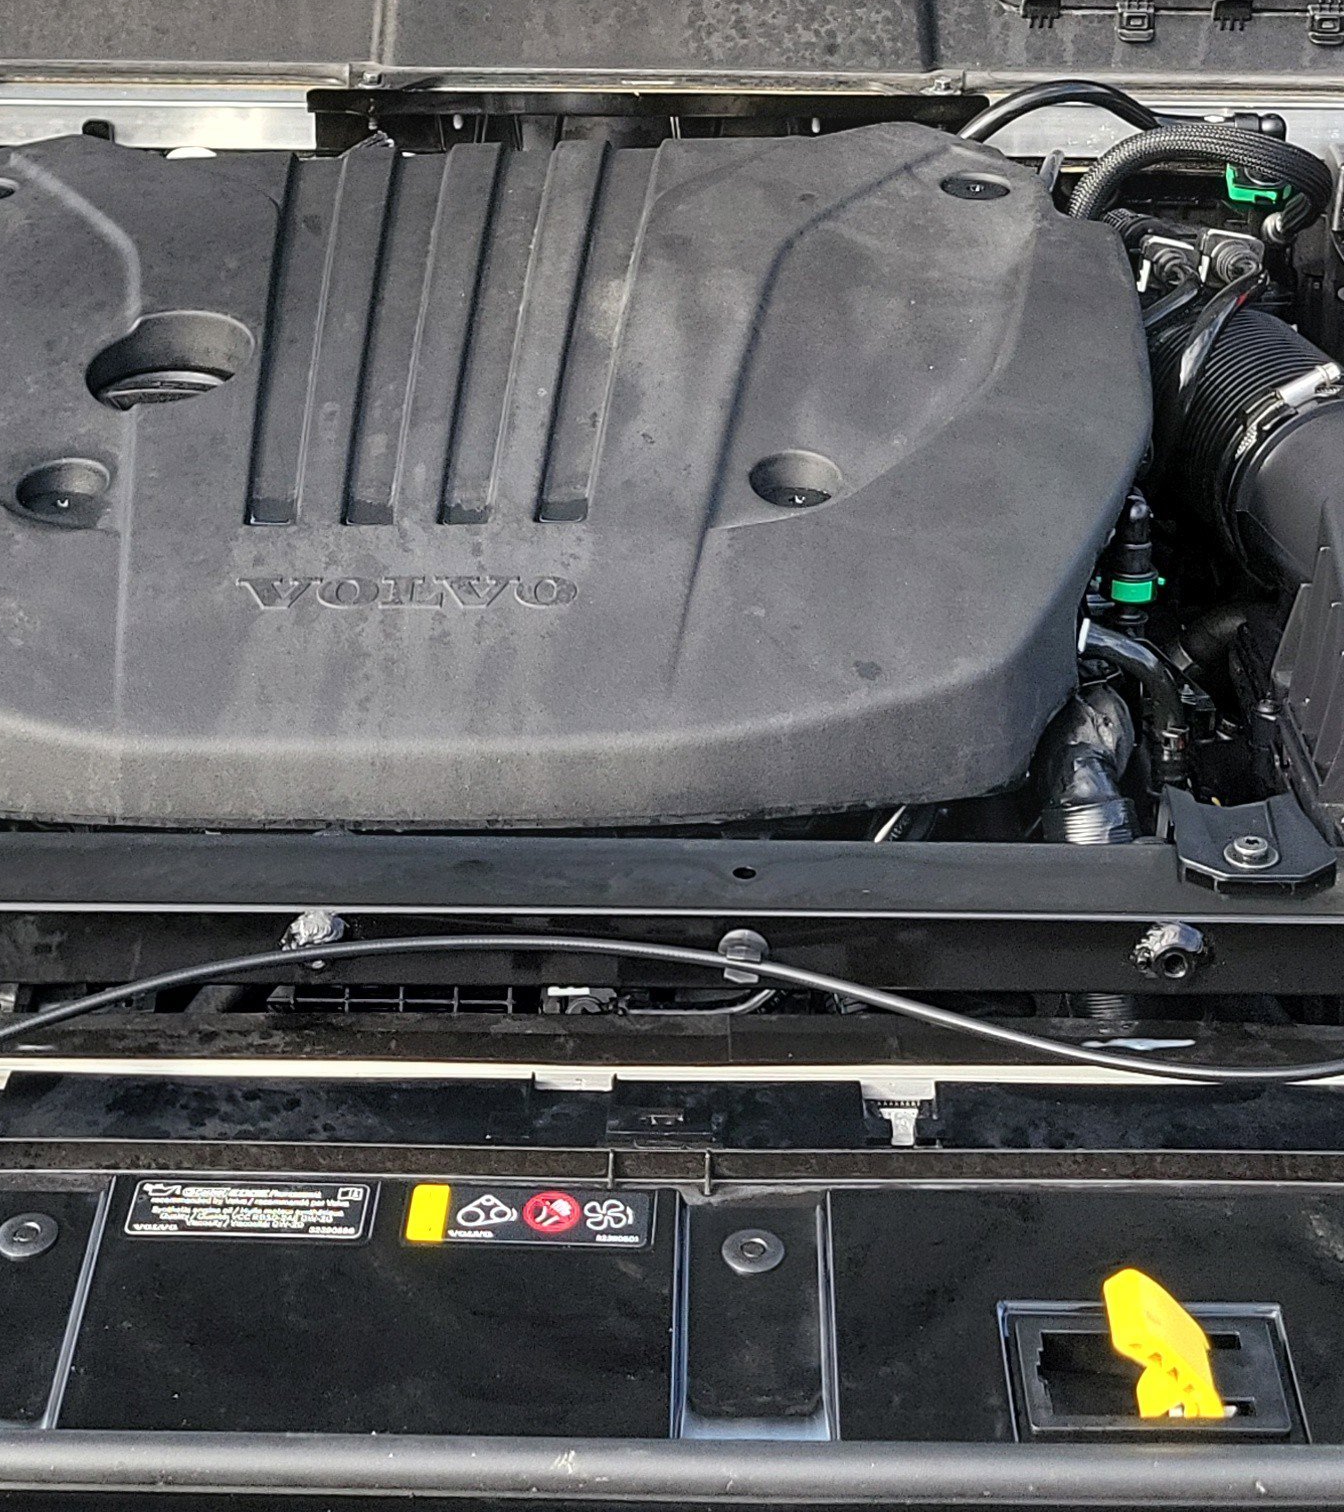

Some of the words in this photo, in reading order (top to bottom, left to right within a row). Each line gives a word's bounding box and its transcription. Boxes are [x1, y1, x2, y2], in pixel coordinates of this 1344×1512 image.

[236, 576, 579, 610] VOLVO
[133, 1223, 178, 1231] VOLVO
[447, 1230, 494, 1238] VOLVO
